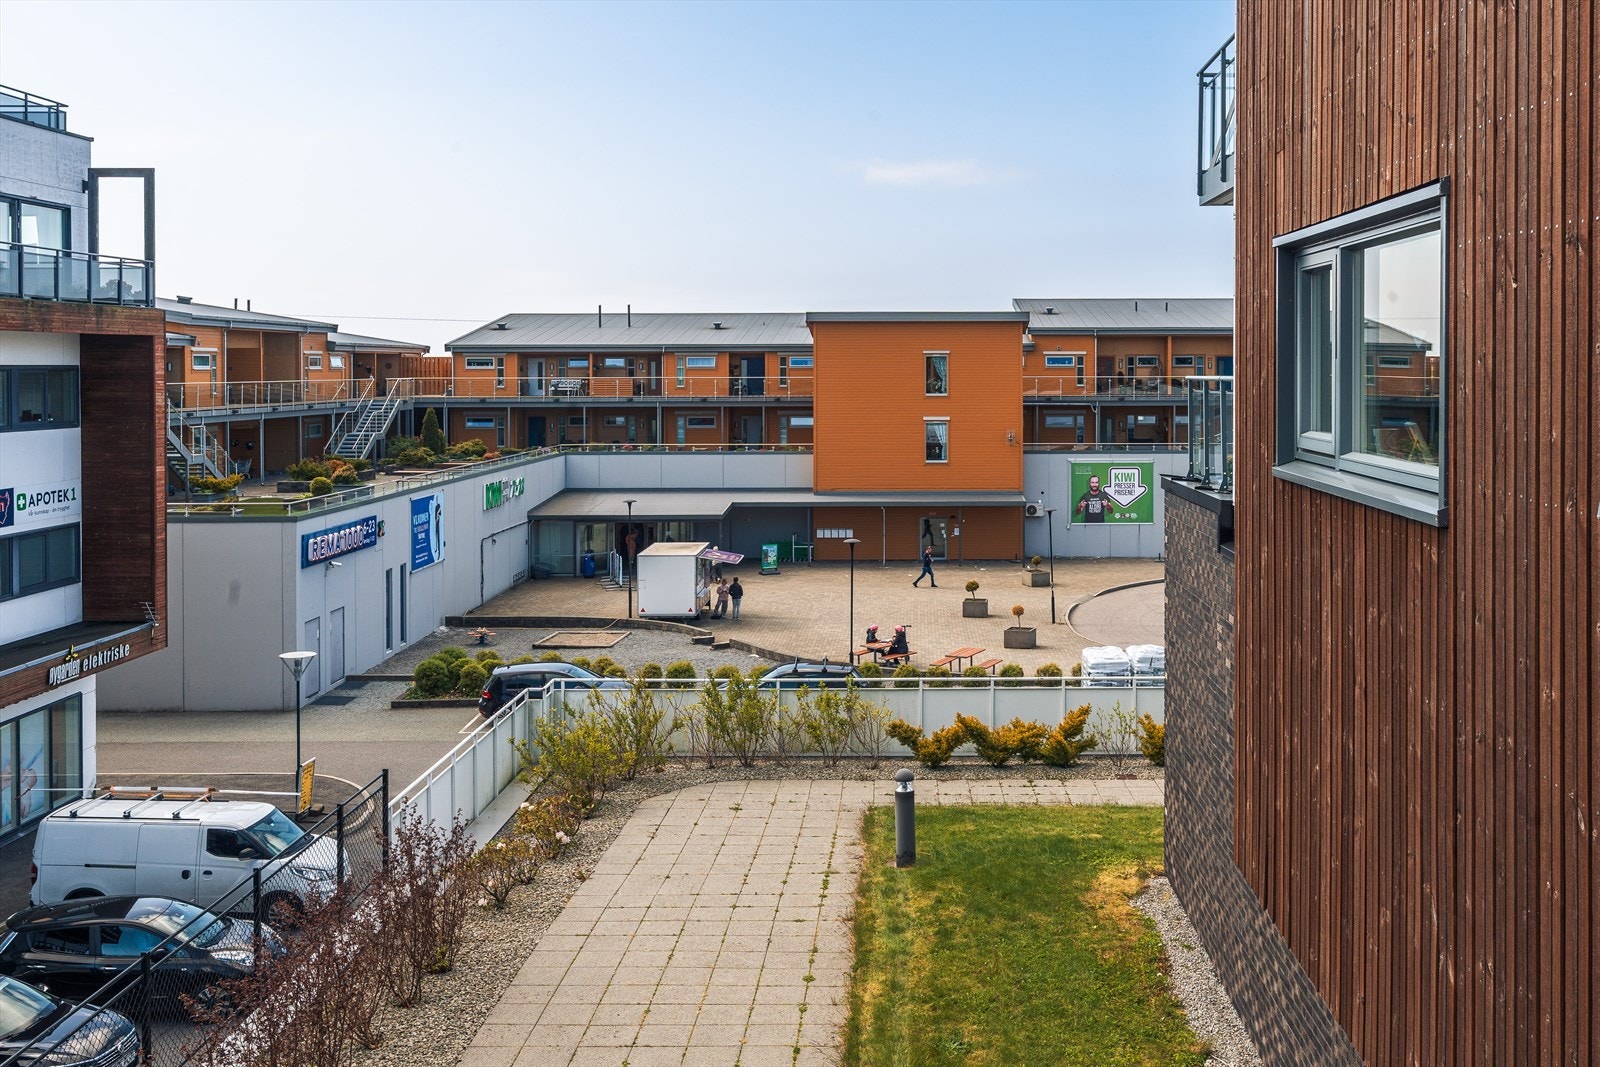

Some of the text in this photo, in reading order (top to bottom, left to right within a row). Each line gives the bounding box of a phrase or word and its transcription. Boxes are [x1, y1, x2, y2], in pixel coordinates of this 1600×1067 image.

[1114, 472, 1136, 483] KIWI
[308, 532, 341, 561] REMA
[83, 643, 130, 671] elektriske
